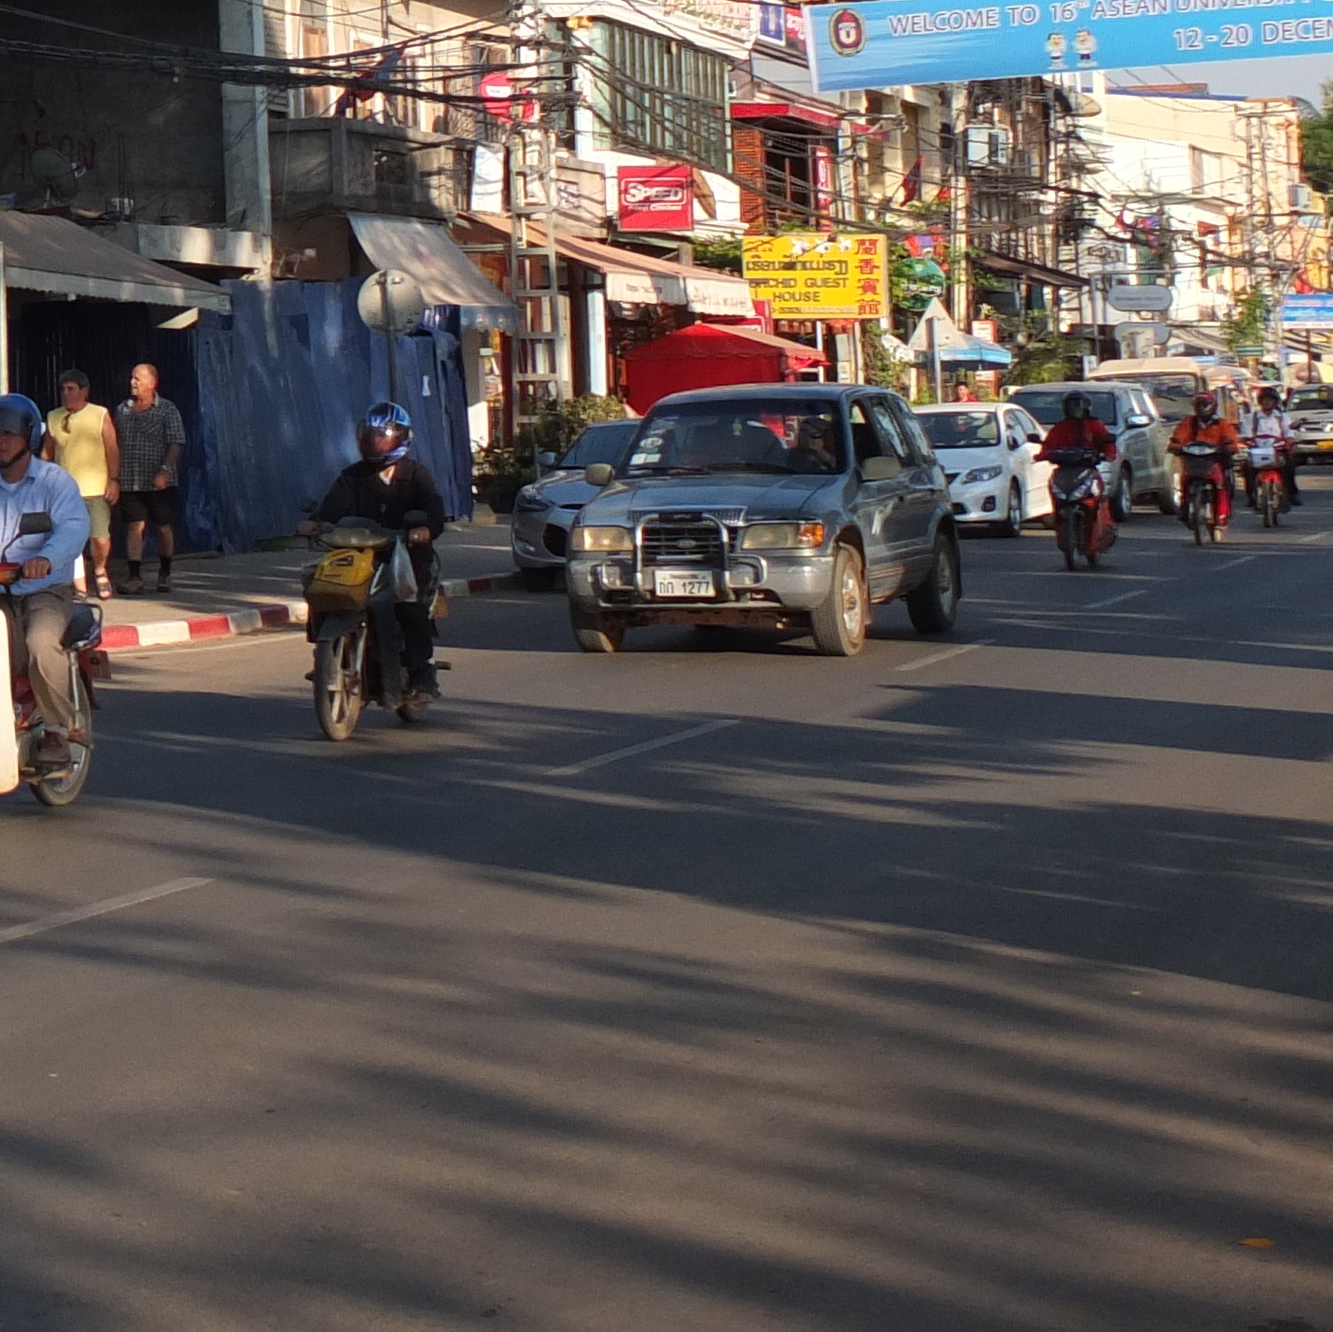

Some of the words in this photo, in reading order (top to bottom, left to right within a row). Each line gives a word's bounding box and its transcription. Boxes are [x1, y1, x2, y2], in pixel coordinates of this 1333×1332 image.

[889, 8, 999, 35] WELCOME
[1006, 5, 1038, 25] TO
[626, 183, 683, 202] SPEED
[804, 277, 849, 289] GUEST
[773, 292, 821, 303] HOUSE
[681, 581, 710, 594] 1277
